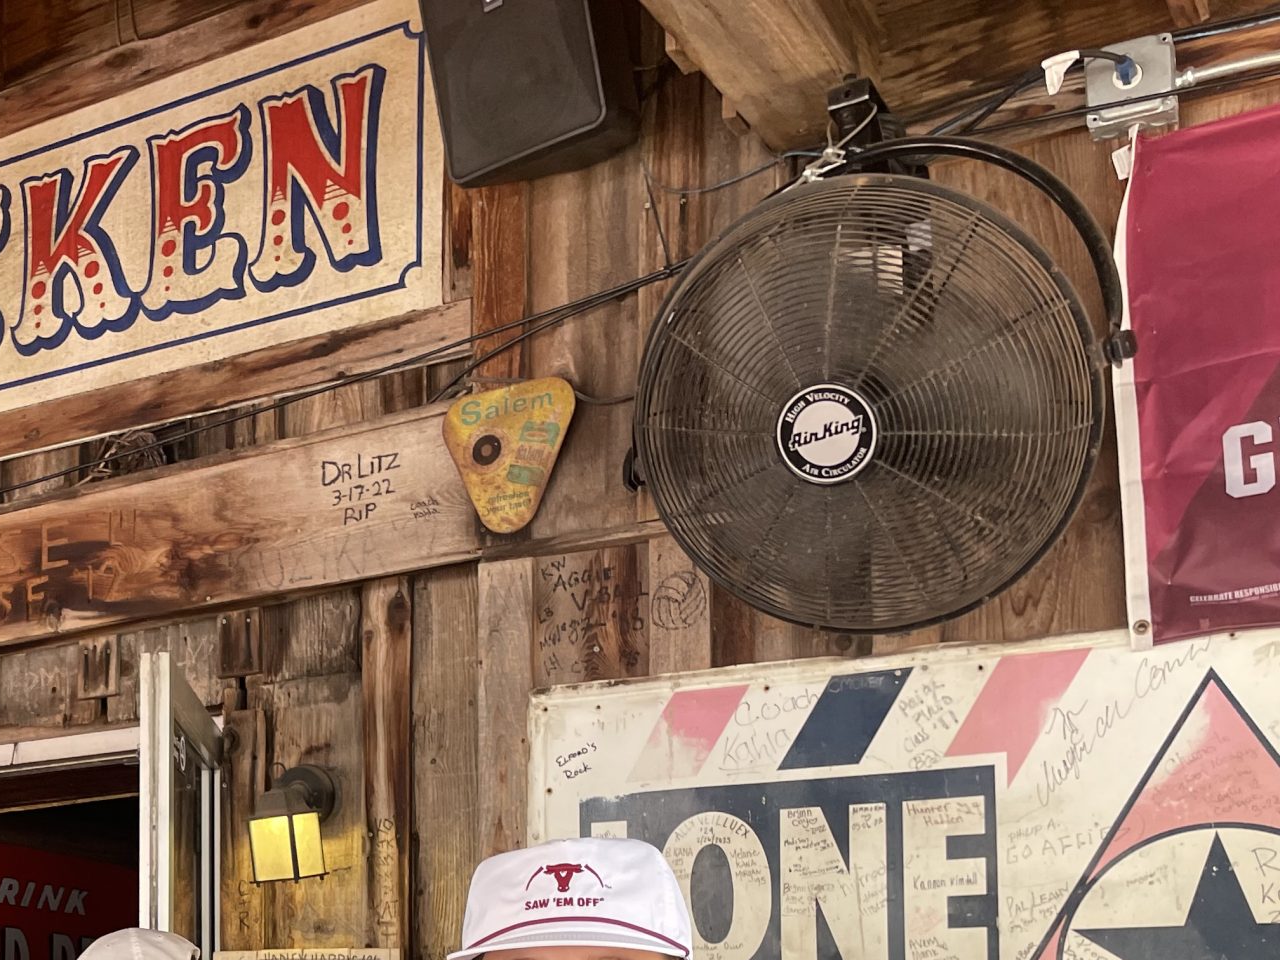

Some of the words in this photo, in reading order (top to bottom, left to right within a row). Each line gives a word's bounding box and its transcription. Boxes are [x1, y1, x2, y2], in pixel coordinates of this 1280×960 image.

[461, 392, 553, 426] Salem
[524, 898, 550, 911] SAW
[553, 897, 574, 907] 'EM
